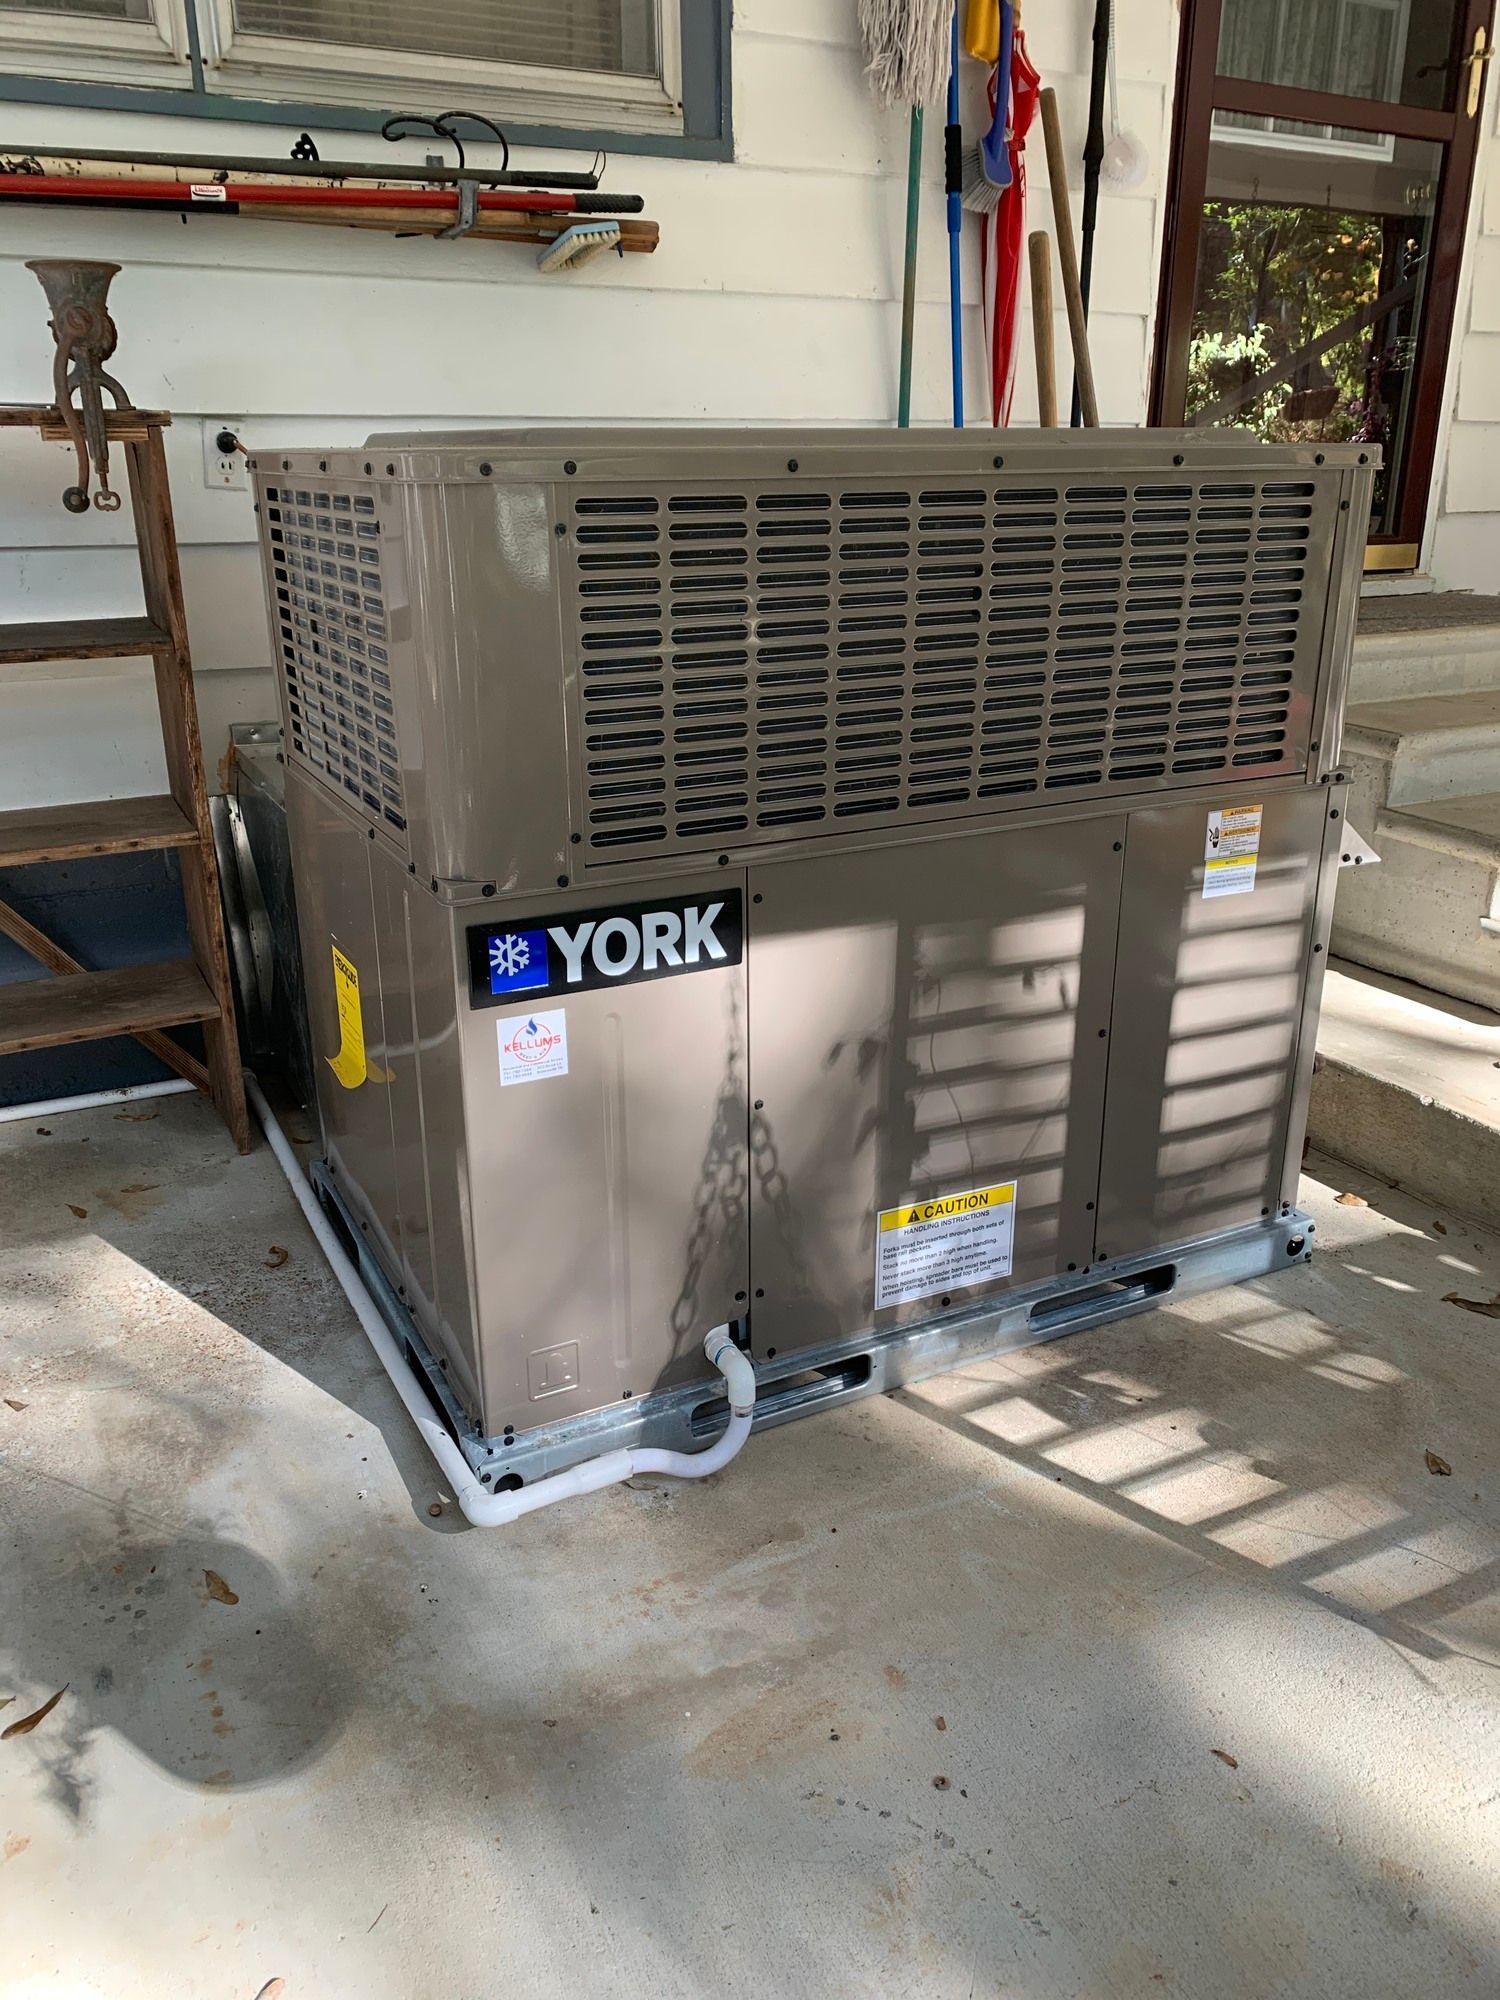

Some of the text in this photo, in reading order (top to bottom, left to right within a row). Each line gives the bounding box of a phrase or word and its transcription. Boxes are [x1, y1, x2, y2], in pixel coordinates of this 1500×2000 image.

[547, 902, 728, 983] YORK
[504, 1034, 561, 1053] KELLUMS
[924, 1193, 989, 1218] CAUTION
[904, 1210, 990, 1235] HANDLING INSTRUCTIONS
[883, 1246, 899, 1254] Forks
[900, 1241, 916, 1249] must
[916, 1238, 924, 1246] be
[925, 1234, 948, 1244] inserted
[949, 1228, 971, 1238] through
[972, 1225, 985, 1233] both
[883, 1262, 898, 1270] Stack
[925, 1252, 938, 1260] than
[943, 1247, 956, 1256] high
[957, 1243, 972, 1252] when
[972, 1238, 998, 1248] handling.
[908, 1244, 932, 1254] pockets.
[882, 1282, 899, 1291] When
[899, 1276, 925, 1287] hoisting,
[926, 1269, 950, 1280] spreader
[951, 1265, 963, 1273] bars
[965, 1261, 979, 1270] must
[988, 1256, 1001, 1264] used
[883, 1272, 899, 1281] Never
[900, 1268, 915, 1276] stack
[933, 1259, 946, 1268] than
[951, 1255, 963, 1264] high
[964, 1250, 987, 1260] anytime.
[882, 1287, 904, 1298] prevent
[904, 1281, 927, 1292] damage
[935, 1275, 950, 1284] sides
[963, 1269, 972, 1277] top
[980, 1264, 992, 1272] unit.
